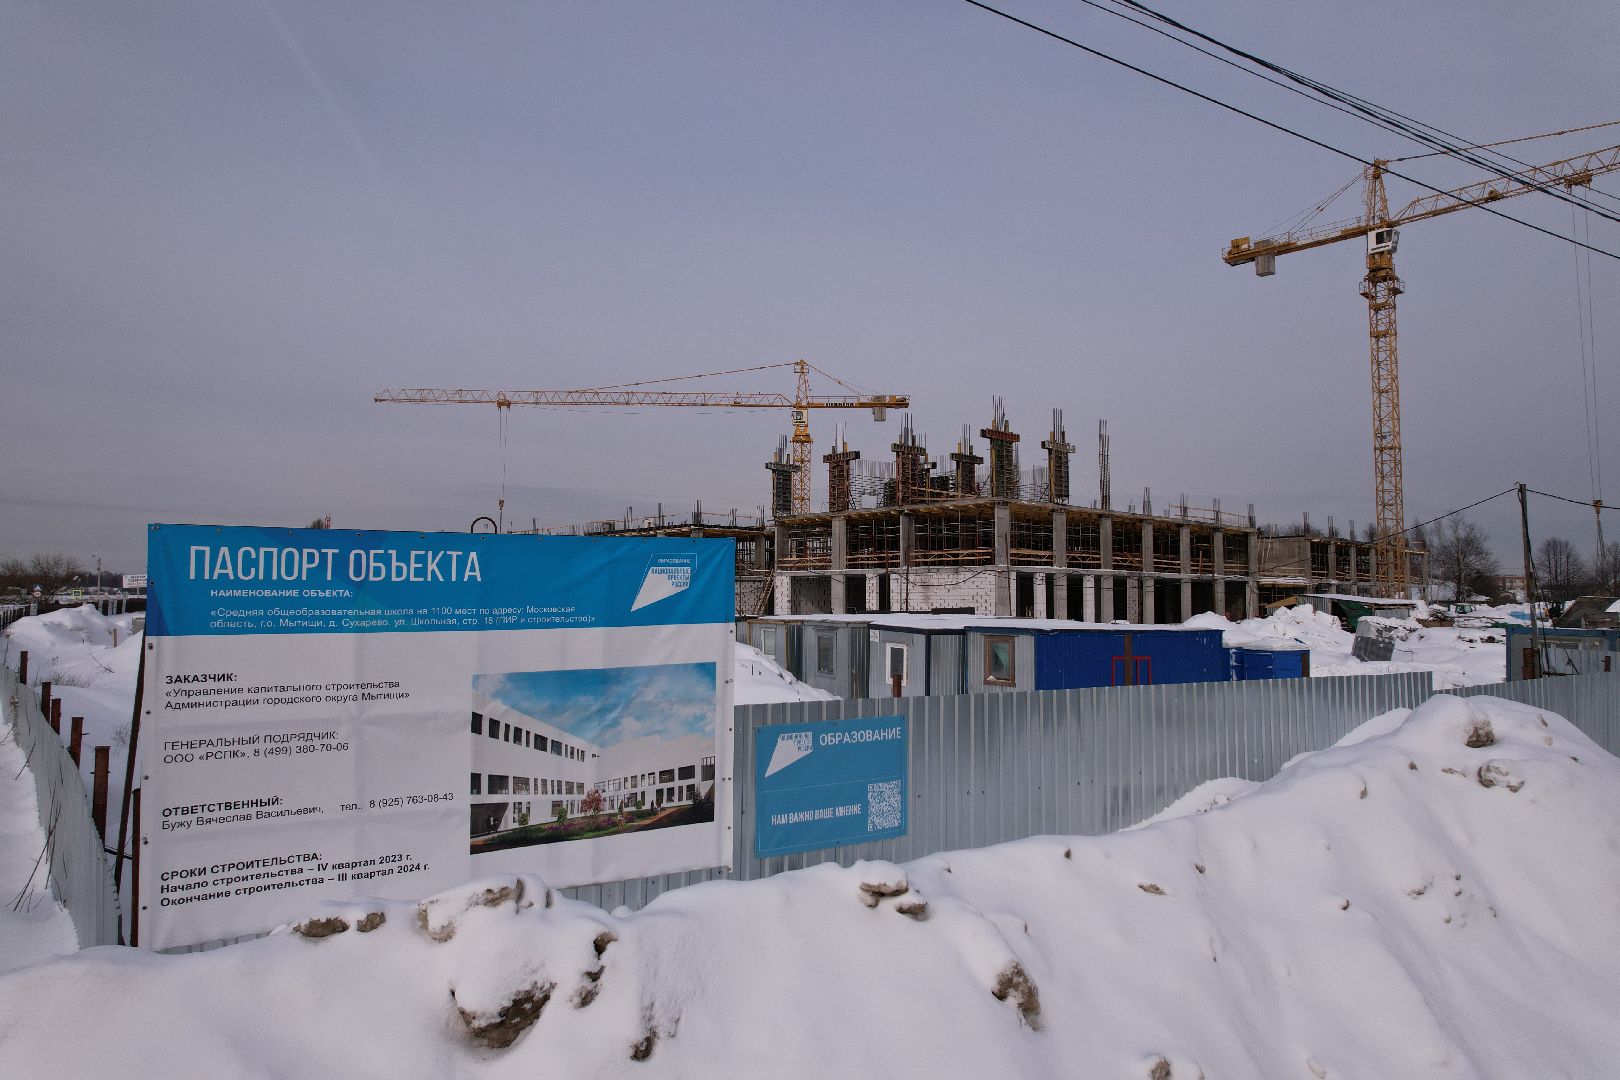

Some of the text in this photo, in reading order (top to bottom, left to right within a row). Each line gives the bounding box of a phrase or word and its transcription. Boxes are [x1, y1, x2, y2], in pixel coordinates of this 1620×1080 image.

[188, 545, 482, 582] ПАСПОРТ ОБЪЕКТА
[210, 589, 354, 598] НАИМЕНОВАНИЕ ОБЪЕКТА:
[210, 607, 264, 618] «Средняя
[267, 607, 382, 618] общеобразовательная
[384, 607, 414, 616] школа
[431, 606, 453, 615] 1100
[492, 606, 524, 617] адресу:
[526, 605, 576, 614] Московская
[209, 619, 257, 629] область,
[279, 618, 326, 628] Мытищи,
[410, 616, 460, 626] Школьная,
[462, 617, 480, 627] стр.
[165, 672, 238, 684] ЗАКАЗЧИК:
[165, 680, 400, 699] «Управление капитального строительства
[164, 690, 410, 711] Администрации городского округа Мытищи»
[163, 730, 339, 751] ГЕНЕРАЛЬНЫЙ ПОДРЯДЧИК:
[819, 727, 902, 746] ОБРАЗОВАНИЕ
[163, 752, 195, 764] ООО
[253, 748, 260, 757] 8
[263, 745, 292, 759] (499)
[161, 795, 284, 818] ОТВЕТСТВЕННЫЙ:
[161, 818, 193, 831] Бужу
[196, 813, 252, 826] Вячеслав
[255, 805, 324, 820] Васильевич,
[369, 799, 376, 809] 8
[378, 797, 404, 809] (925)
[406, 792, 454, 805] 763-08-43
[771, 803, 862, 826] НАМ ВАЖНО ВАШЕ МНЕНИЕ
[160, 852, 323, 882] СРОКИ СТРОИТЕЛЬСТВА:
[160, 878, 209, 894] Начало
[212, 866, 304, 887] строительства
[317, 862, 329, 873] IV
[331, 859, 376, 872] квартал
[378, 853, 403, 865] 2023
[405, 854, 413, 862] г.
[160, 889, 231, 908] Окончание
[234, 876, 325, 896] строительства
[337, 872, 348, 882] III
[350, 868, 394, 882] квартал
[396, 862, 421, 875] 2024
[423, 863, 431, 871] г.
